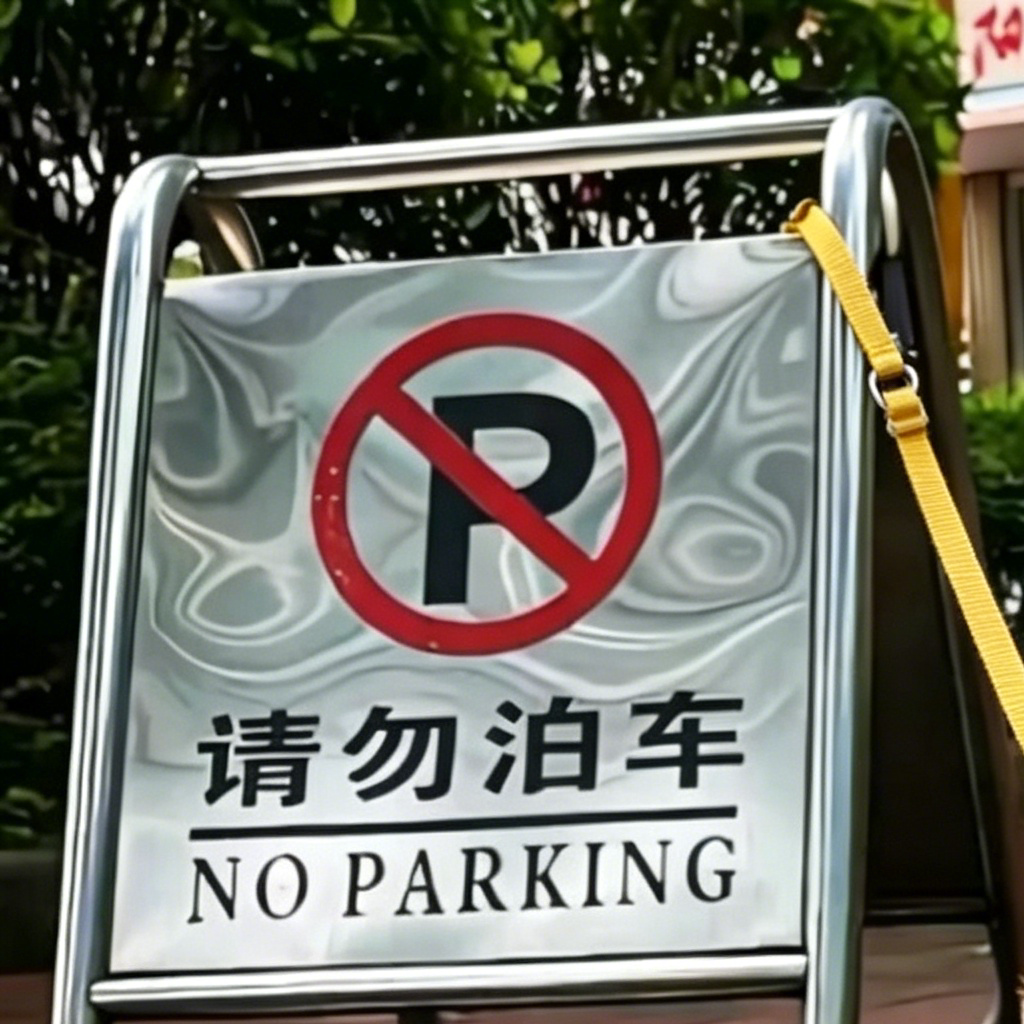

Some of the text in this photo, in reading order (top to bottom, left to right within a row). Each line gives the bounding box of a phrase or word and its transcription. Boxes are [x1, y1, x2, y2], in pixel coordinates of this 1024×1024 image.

[423, 392, 596, 606] P
[197, 691, 745, 807] 请勿泊车
[188, 835, 736, 924] NO PARKING
